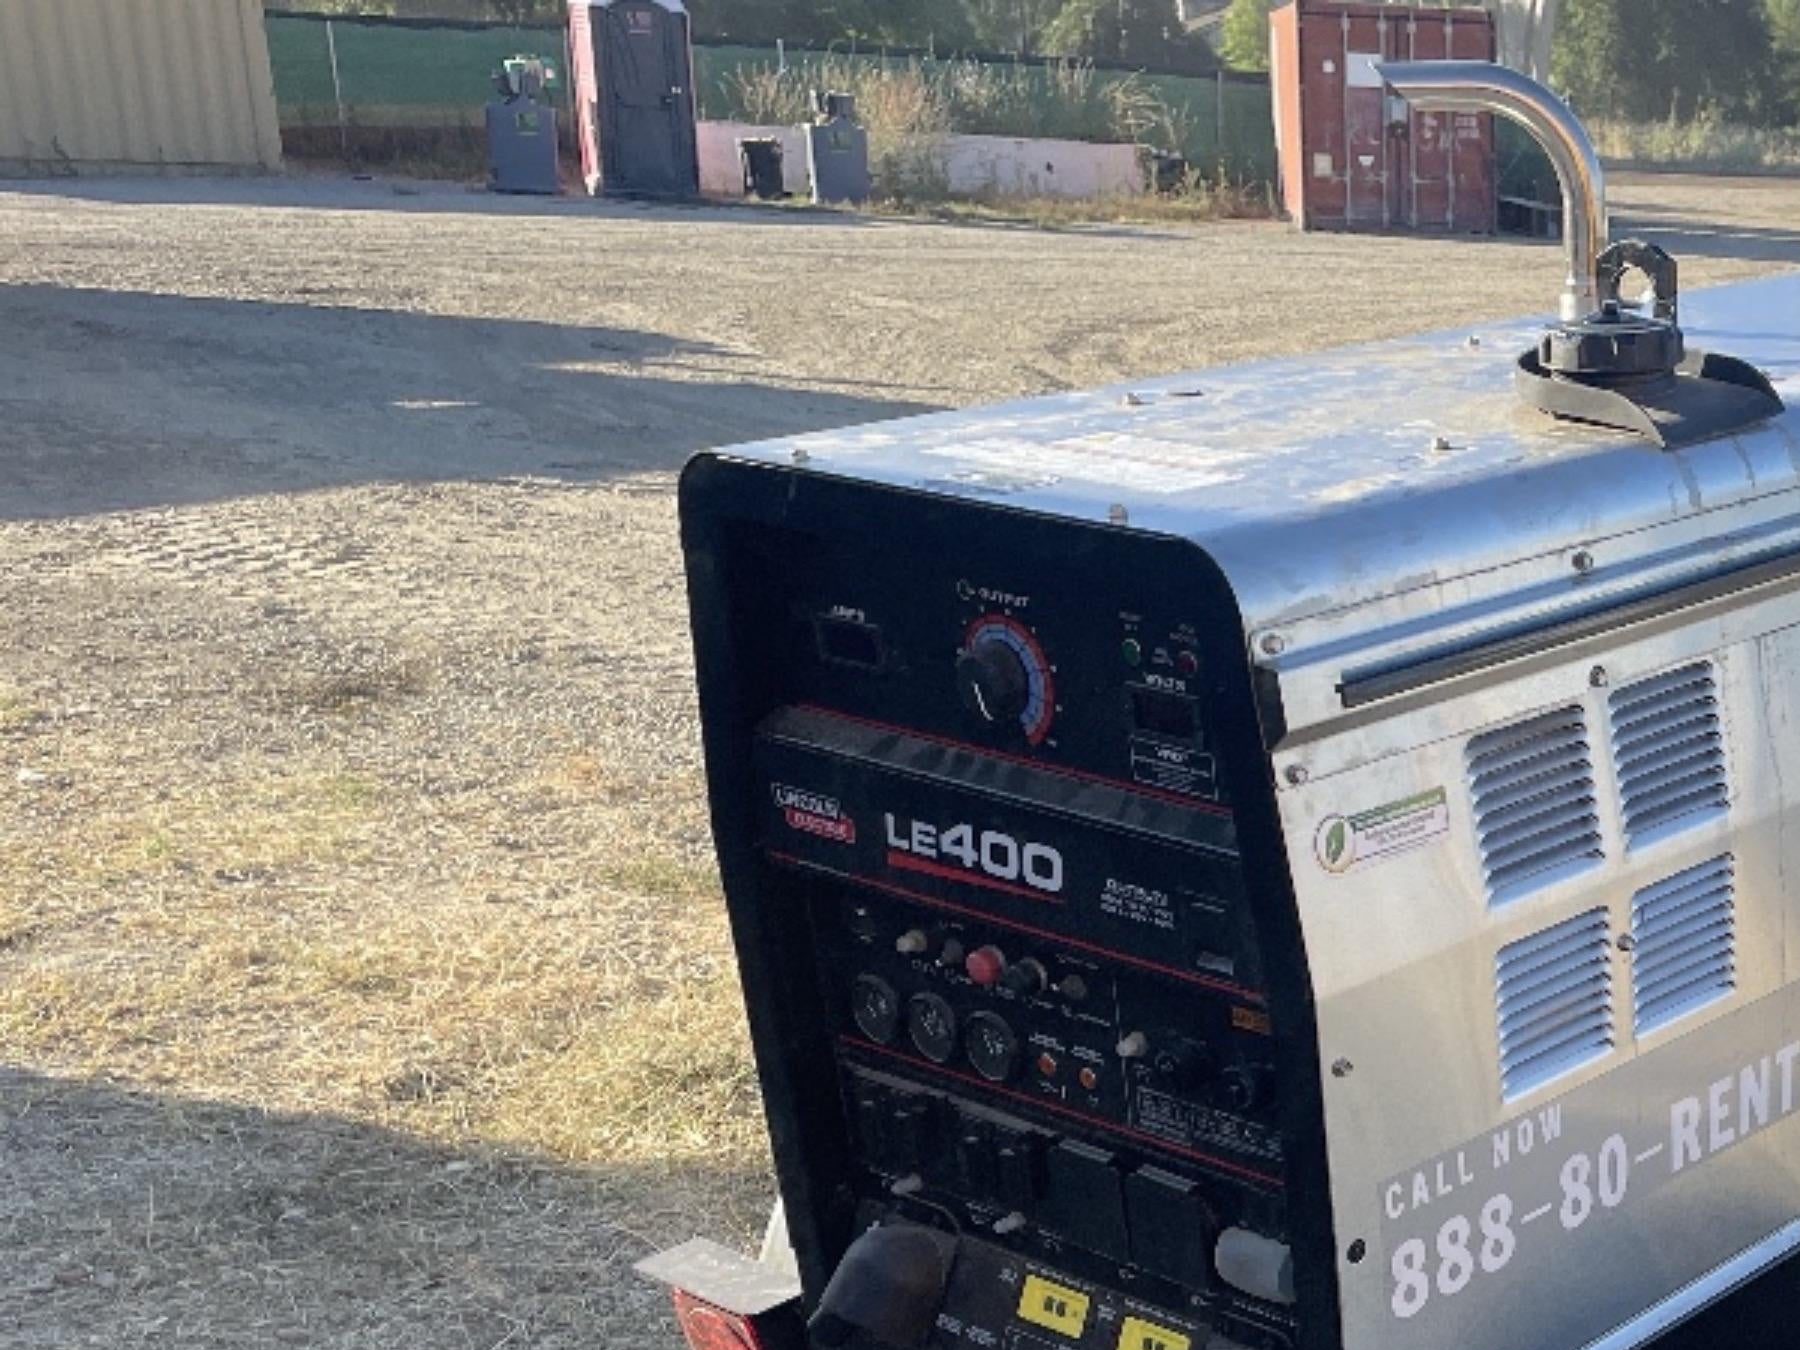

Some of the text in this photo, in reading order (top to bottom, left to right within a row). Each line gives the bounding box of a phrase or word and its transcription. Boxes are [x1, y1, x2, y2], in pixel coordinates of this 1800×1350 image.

[884, 811, 1064, 893] LE400
[1384, 1102, 1563, 1220] CALL NOW
